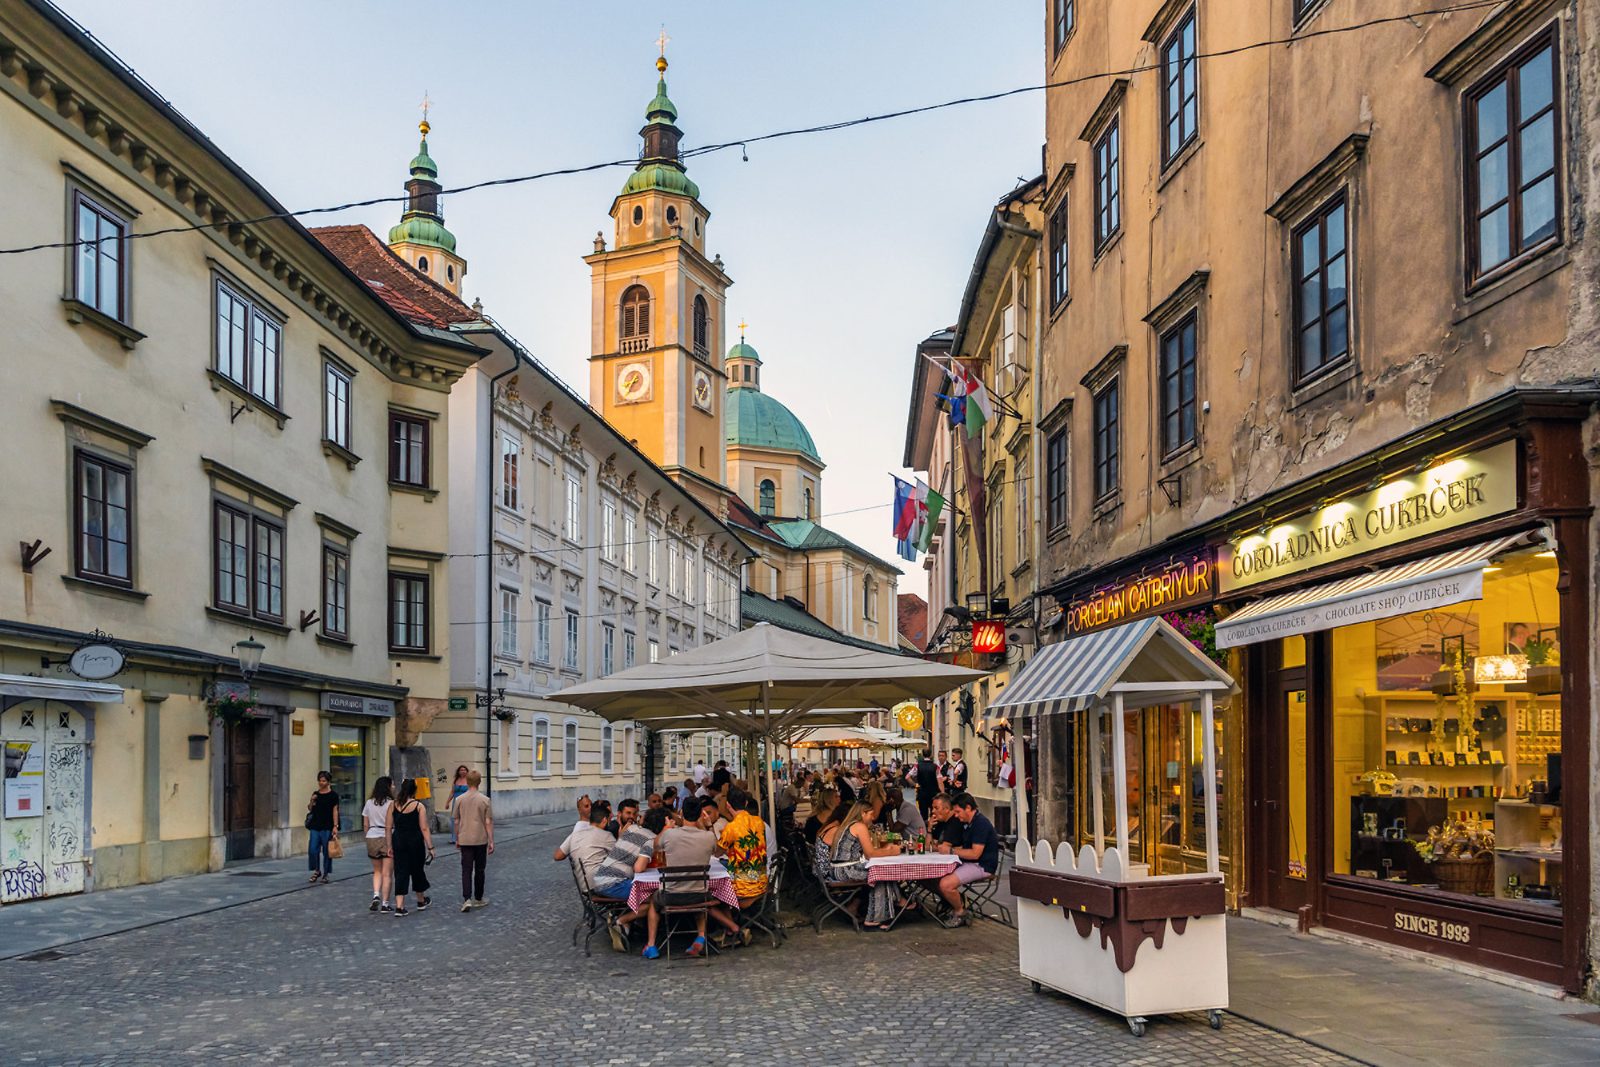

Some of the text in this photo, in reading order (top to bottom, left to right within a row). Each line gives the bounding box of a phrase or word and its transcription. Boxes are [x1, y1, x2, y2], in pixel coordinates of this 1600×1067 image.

[1232, 473, 1488, 579] ČOKOLADNICA CUKRČEK
[1325, 601, 1376, 621] CHOCOLATE
[1378, 595, 1406, 610] SHOP
[974, 625, 1004, 651] illy
[1394, 912, 1470, 943] SINCE 1993
